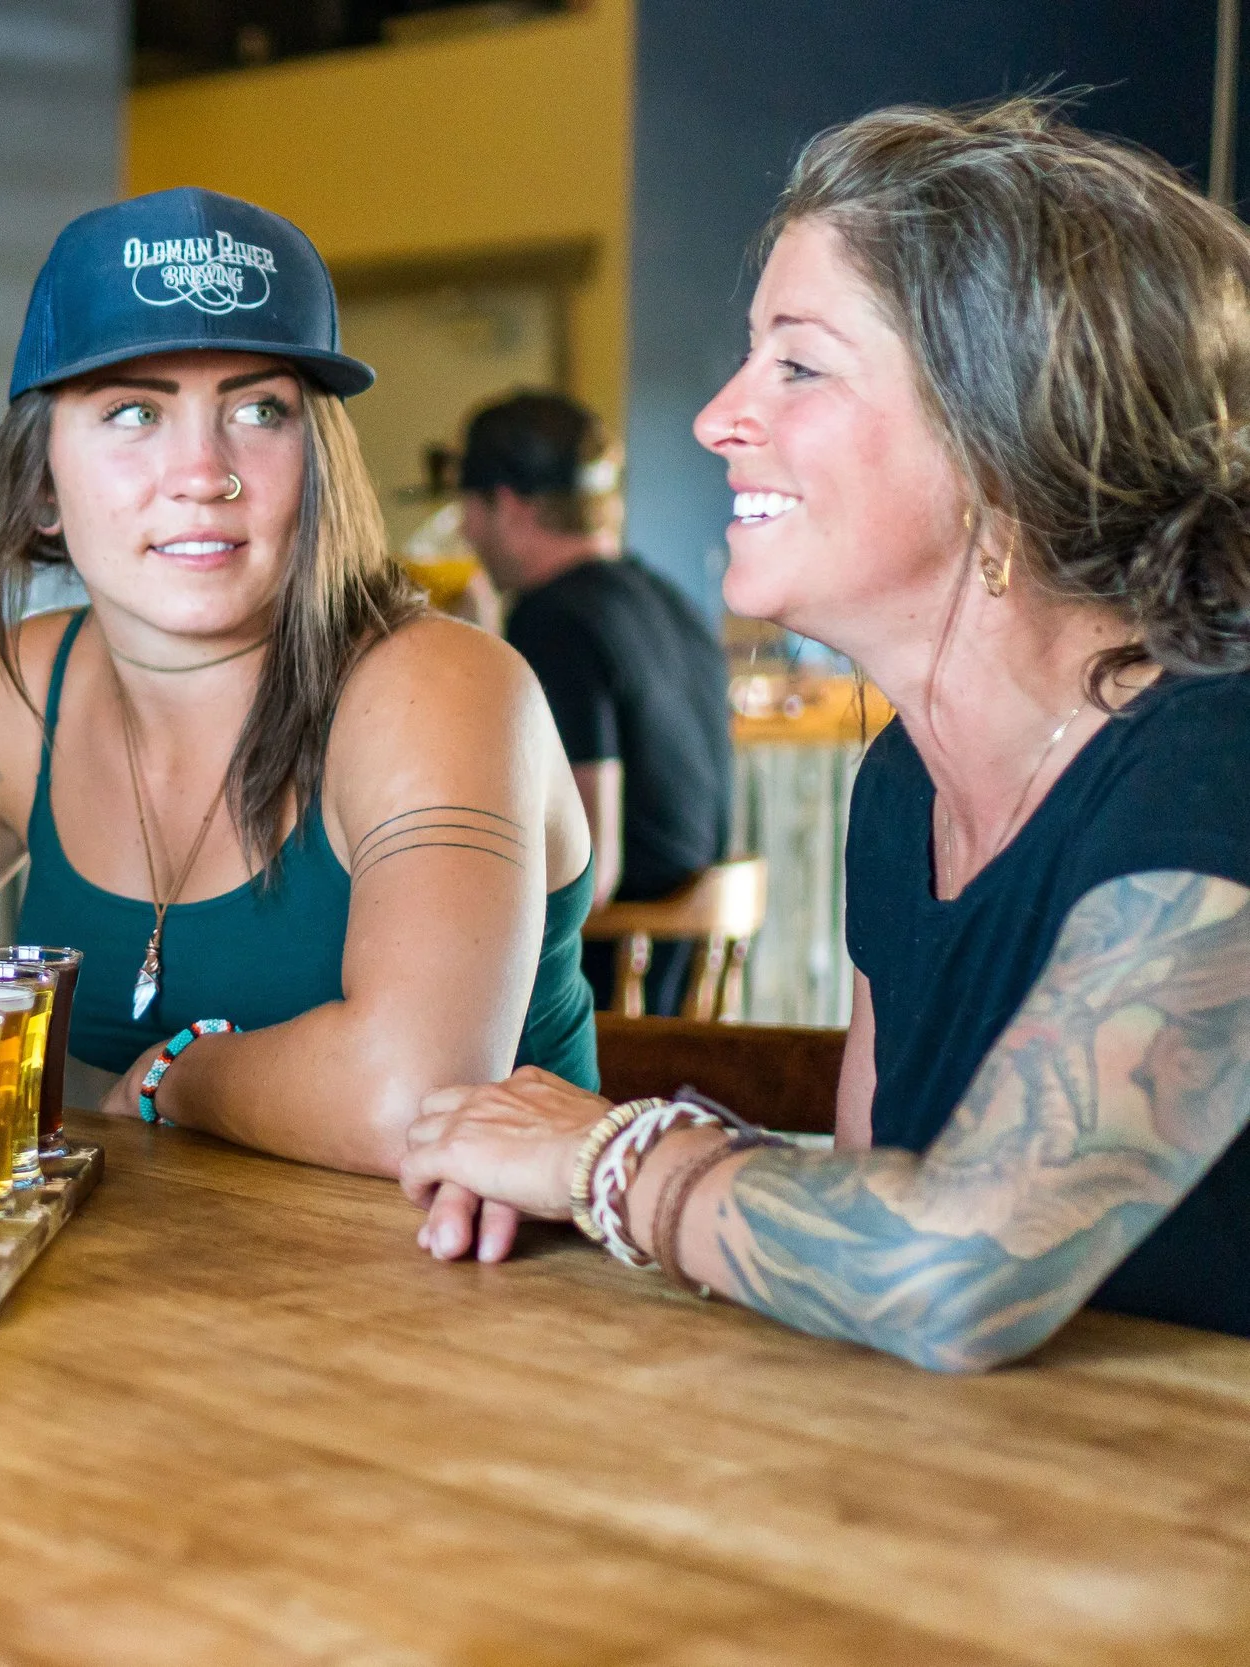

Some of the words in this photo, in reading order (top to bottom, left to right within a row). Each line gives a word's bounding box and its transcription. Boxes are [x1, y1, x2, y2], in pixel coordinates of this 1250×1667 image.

[124, 237, 213, 268] OLDMAN
[215, 230, 278, 272] RIVER
[161, 264, 243, 291] BREWING
